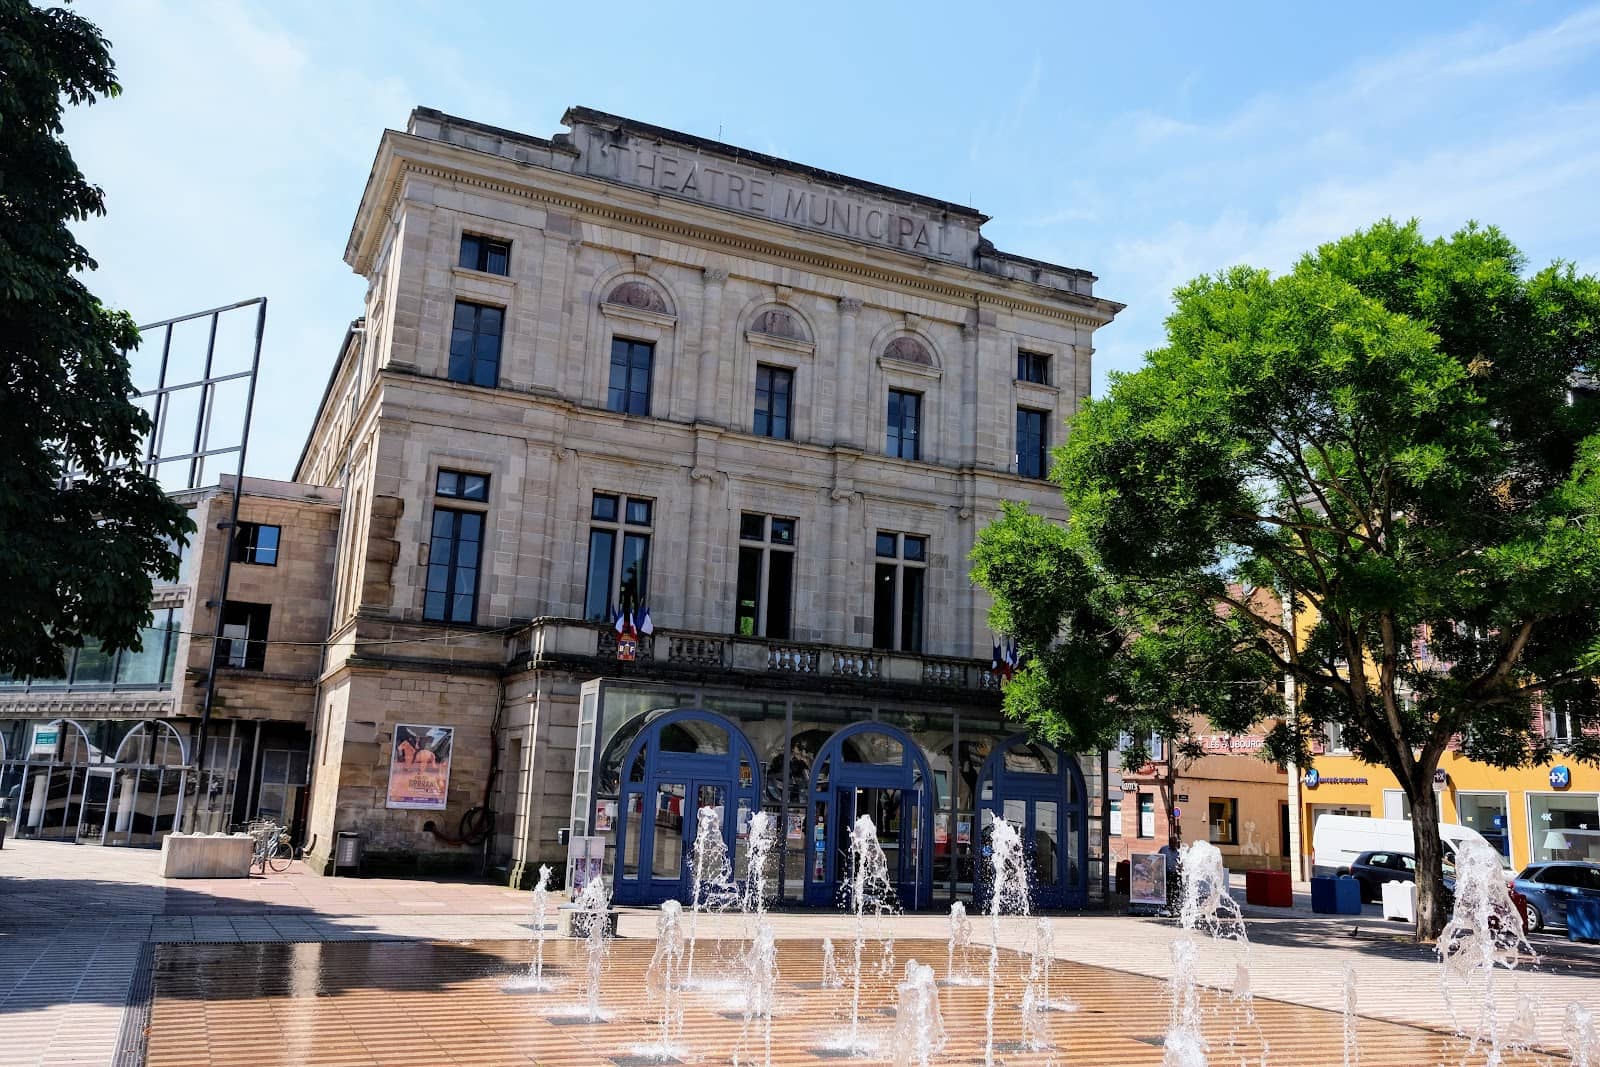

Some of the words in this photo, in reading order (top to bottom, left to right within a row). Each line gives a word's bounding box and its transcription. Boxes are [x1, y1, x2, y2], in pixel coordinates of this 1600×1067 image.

[607, 142, 767, 213] THEATRE
[783, 188, 953, 256] MUNICIPAL
[1207, 740, 1220, 749] LES
